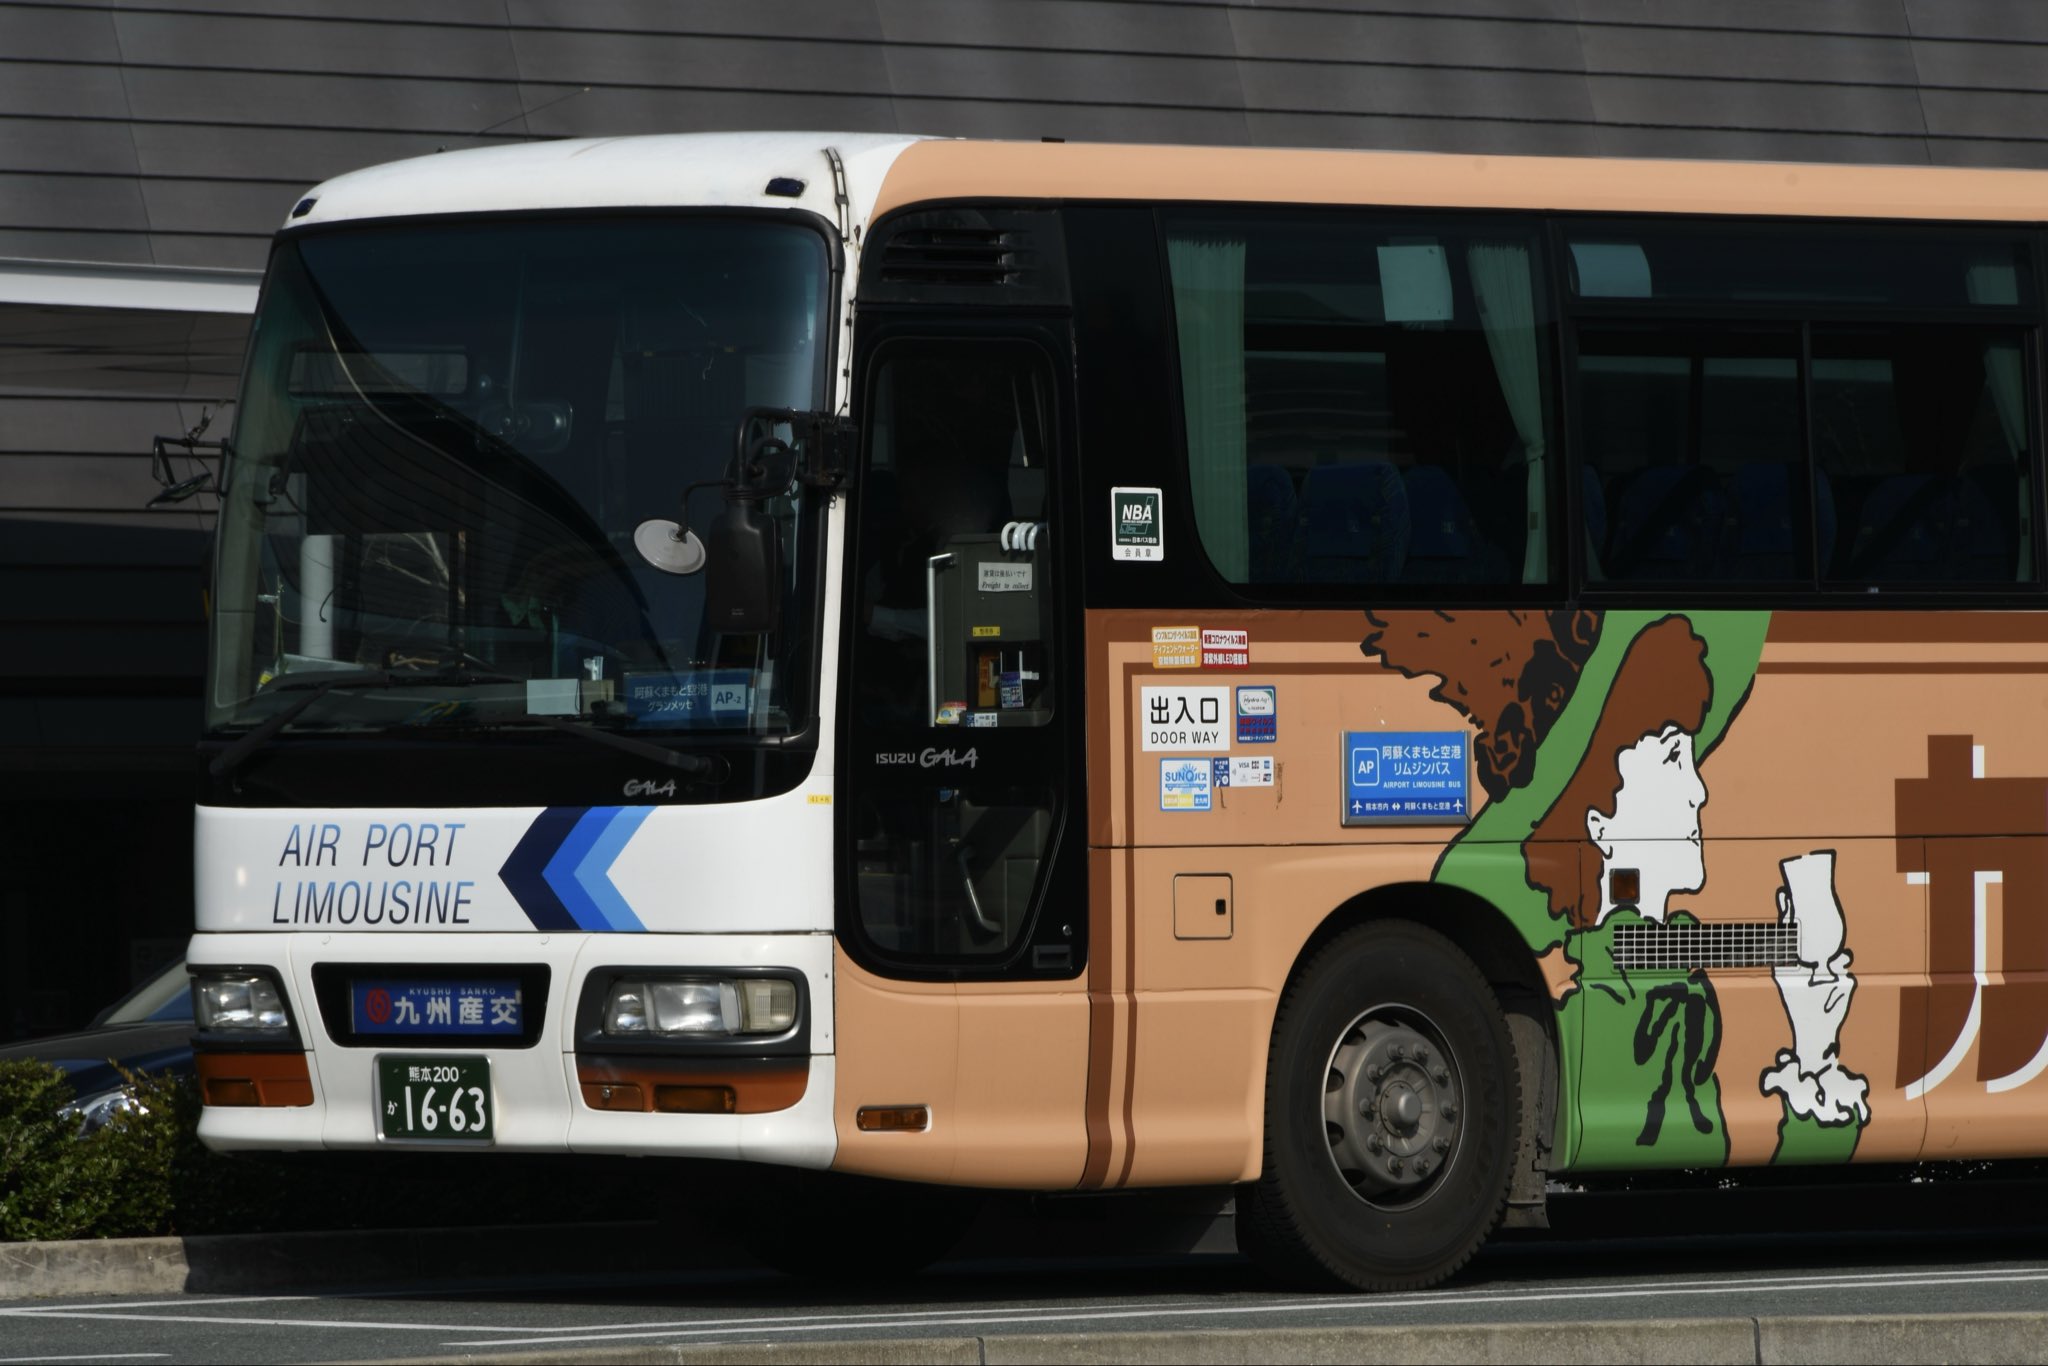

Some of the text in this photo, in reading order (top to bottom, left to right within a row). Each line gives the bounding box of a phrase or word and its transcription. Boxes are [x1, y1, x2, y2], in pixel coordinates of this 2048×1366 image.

[1122, 504, 1152, 520] NBA
[634, 683, 742, 704] 阿蘇くまもと空港 AP-2
[648, 699, 694, 712] グランメッセ
[1150, 695, 1219, 724] 出入口
[1151, 731, 1219, 744] DOOR WAY
[876, 747, 979, 768] ISUZU GALA
[1382, 745, 1461, 759] 阿蘇くまもと空港
[1358, 761, 1375, 774] AP
[1394, 761, 1451, 775] リムジンバス
[623, 778, 677, 797] GALA
[1383, 781, 1410, 789] AIRPORT
[1448, 780, 1461, 788] BUS
[1365, 802, 1451, 811] 熊本市内 阿蘇くまもと空港
[279, 823, 466, 867] AIR PORT
[273, 880, 475, 925] LIMOUSINE
[409, 987, 496, 996] KYUSHU SANKO
[394, 996, 518, 1025] 九州産交
[387, 1086, 486, 1132] か 16-63
